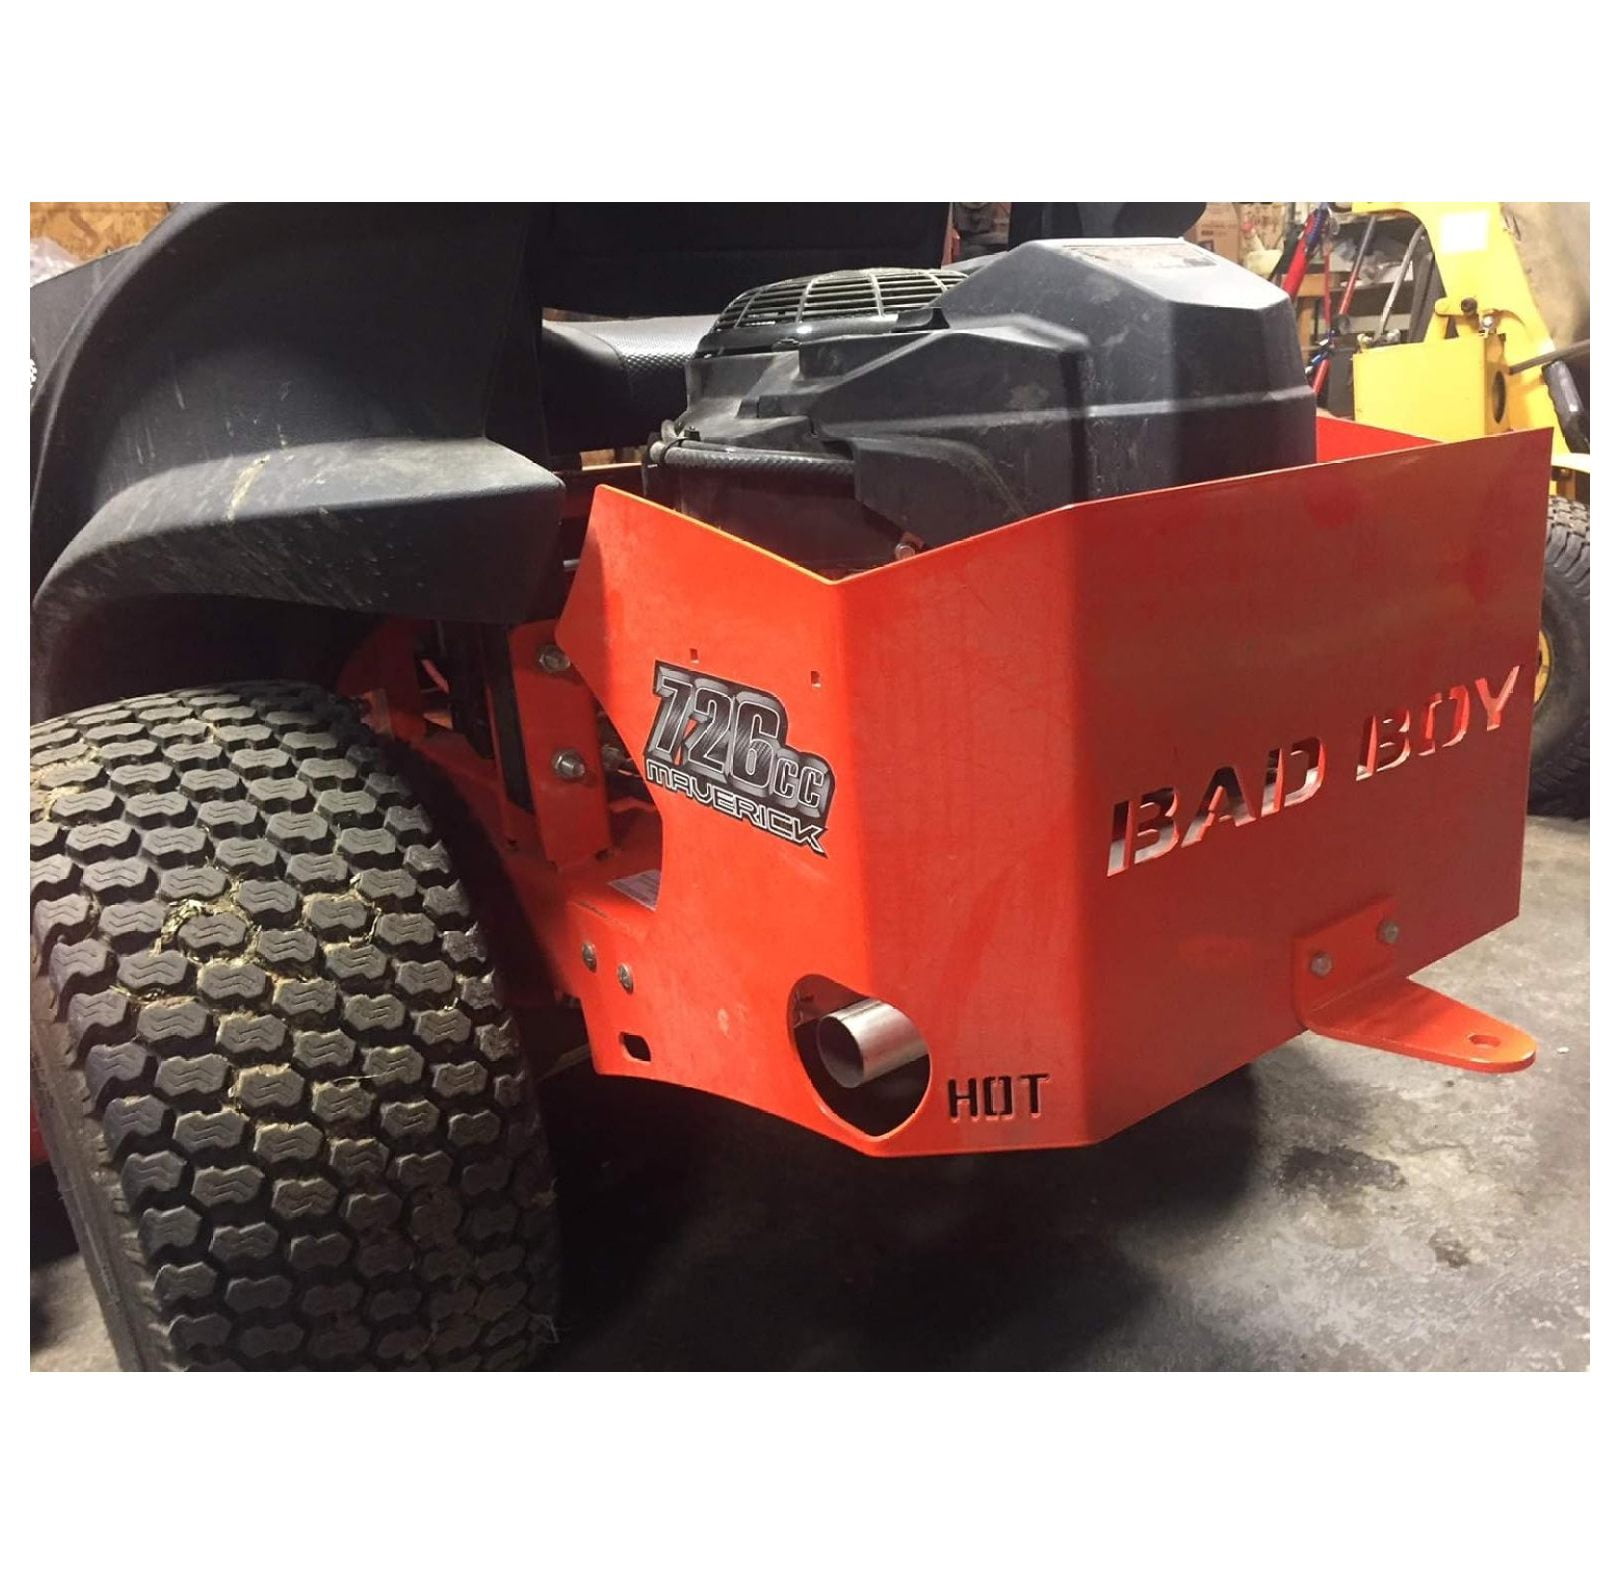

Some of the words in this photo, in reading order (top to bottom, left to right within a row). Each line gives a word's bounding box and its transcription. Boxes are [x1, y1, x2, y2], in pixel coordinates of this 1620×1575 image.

[646, 757, 827, 858] MAVERICK
[1106, 735, 1327, 877] BAD
[1355, 665, 1521, 782] BOY
[947, 1072, 1051, 1122] HOT
